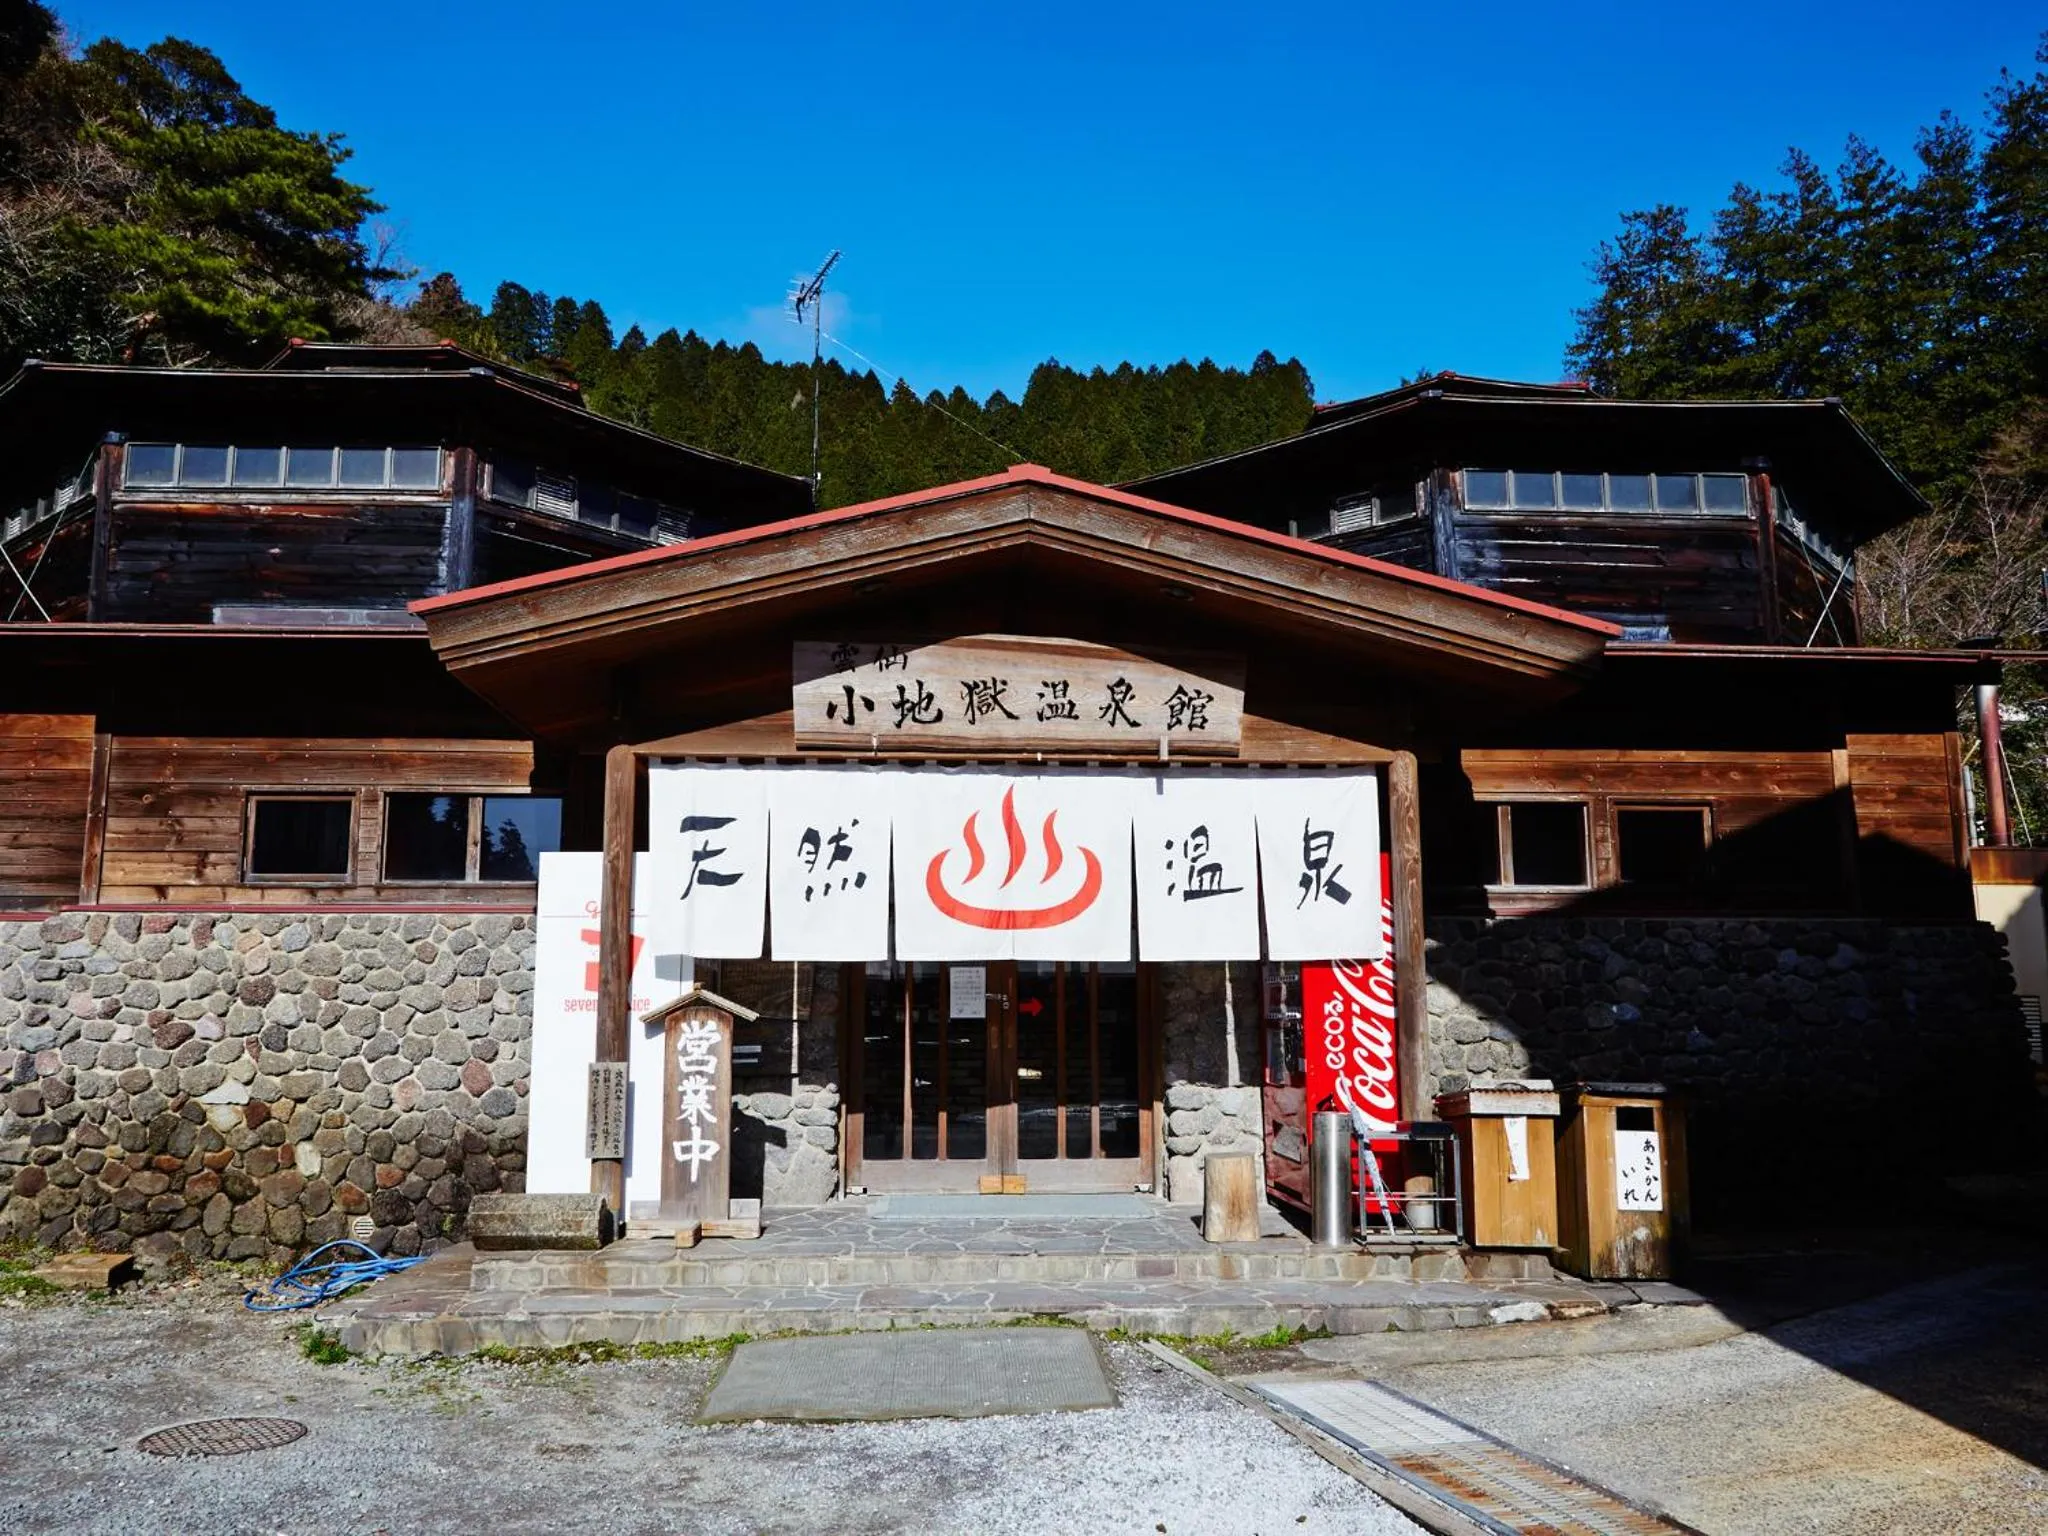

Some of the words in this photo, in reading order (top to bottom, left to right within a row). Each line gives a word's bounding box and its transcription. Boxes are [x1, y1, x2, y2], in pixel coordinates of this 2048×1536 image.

[832, 641, 909, 673] 雲仙
[826, 676, 1215, 731] 小地獄温泉館
[672, 1020, 722, 1183] 営業中
[1622, 1167, 1639, 1204] いれ
[1643, 1138, 1659, 1202] あきかん
